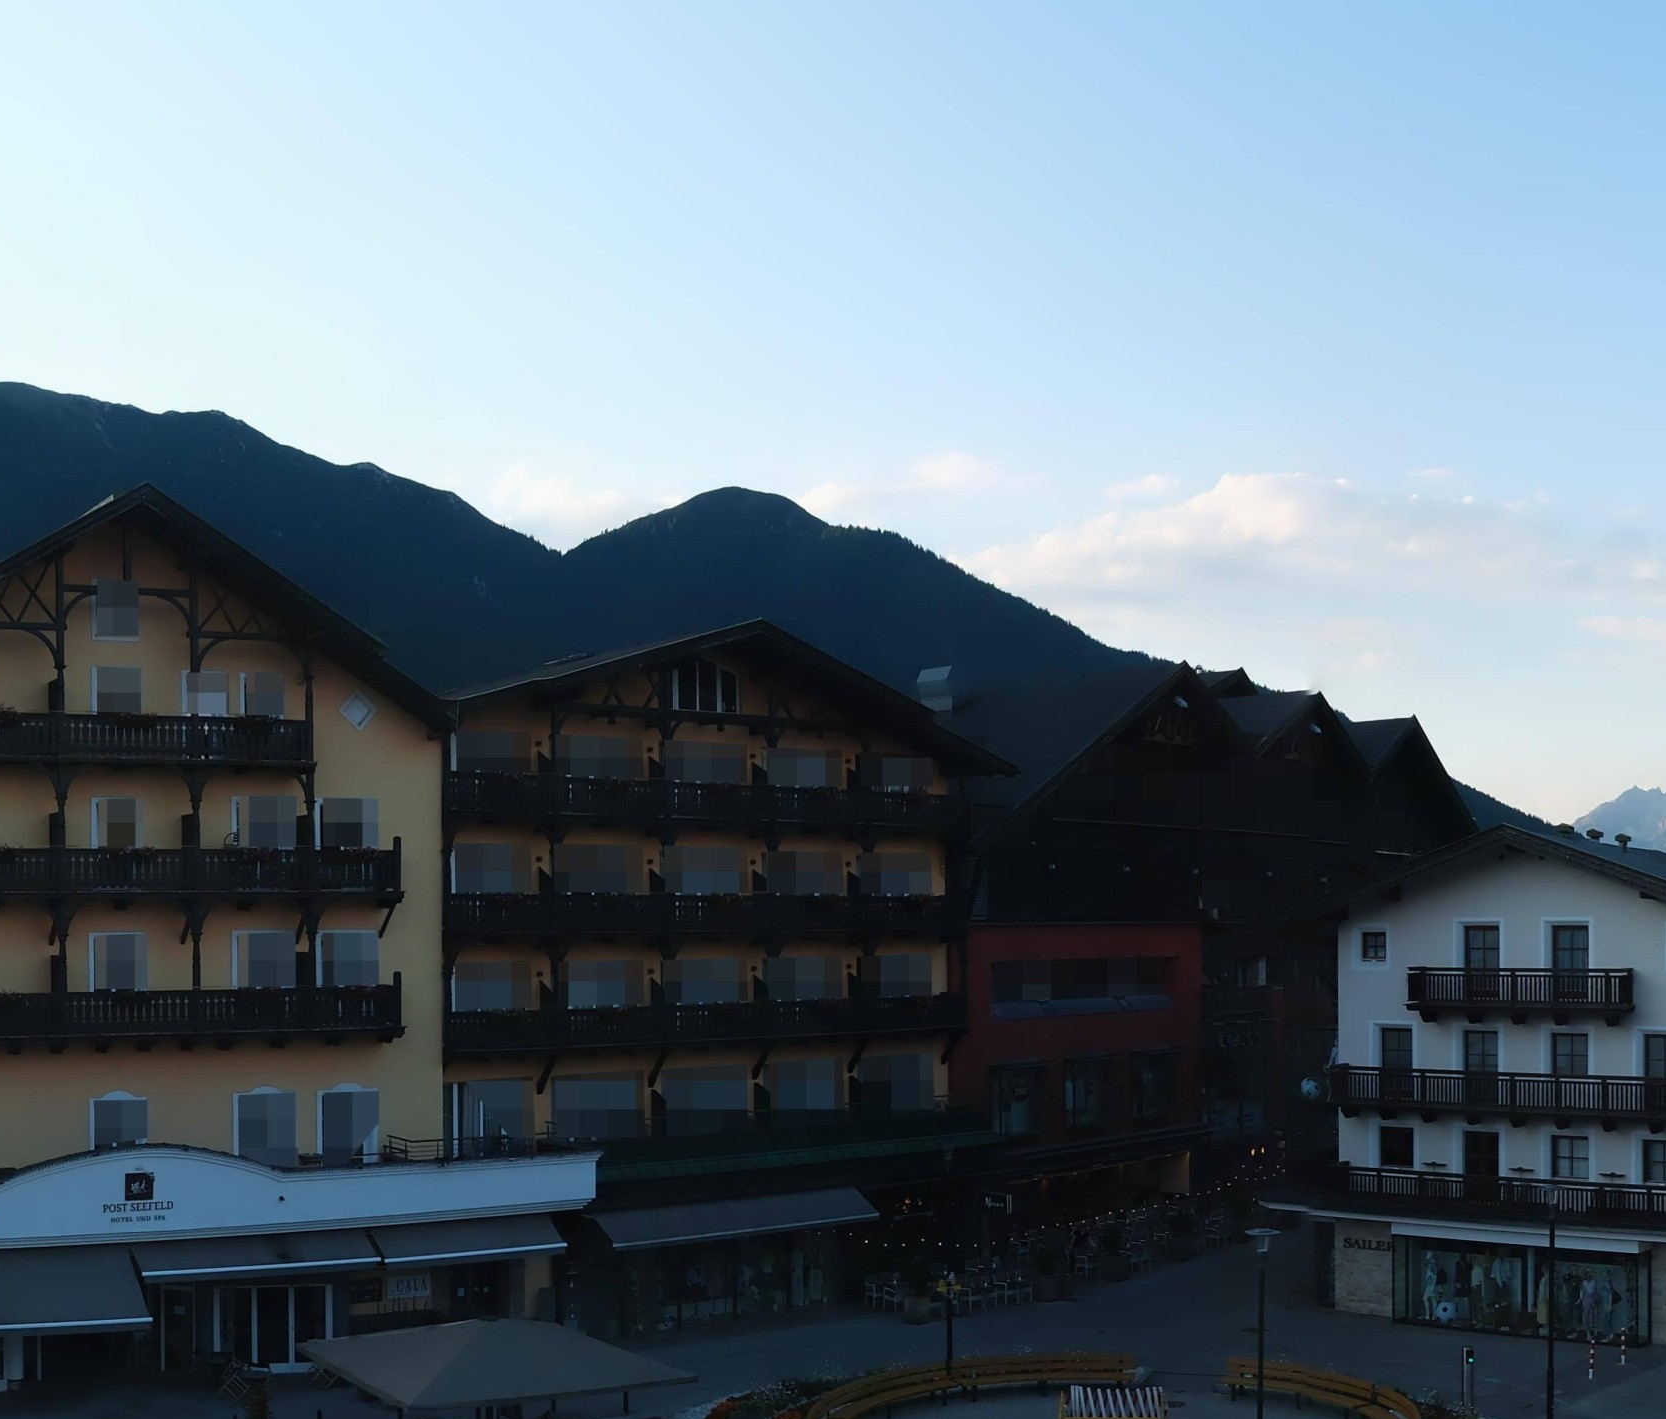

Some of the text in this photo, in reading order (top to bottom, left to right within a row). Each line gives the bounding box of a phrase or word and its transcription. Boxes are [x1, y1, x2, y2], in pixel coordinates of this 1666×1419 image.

[103, 1200, 174, 1213] POST SEEFELD
[396, 1278, 428, 1293] CALA
